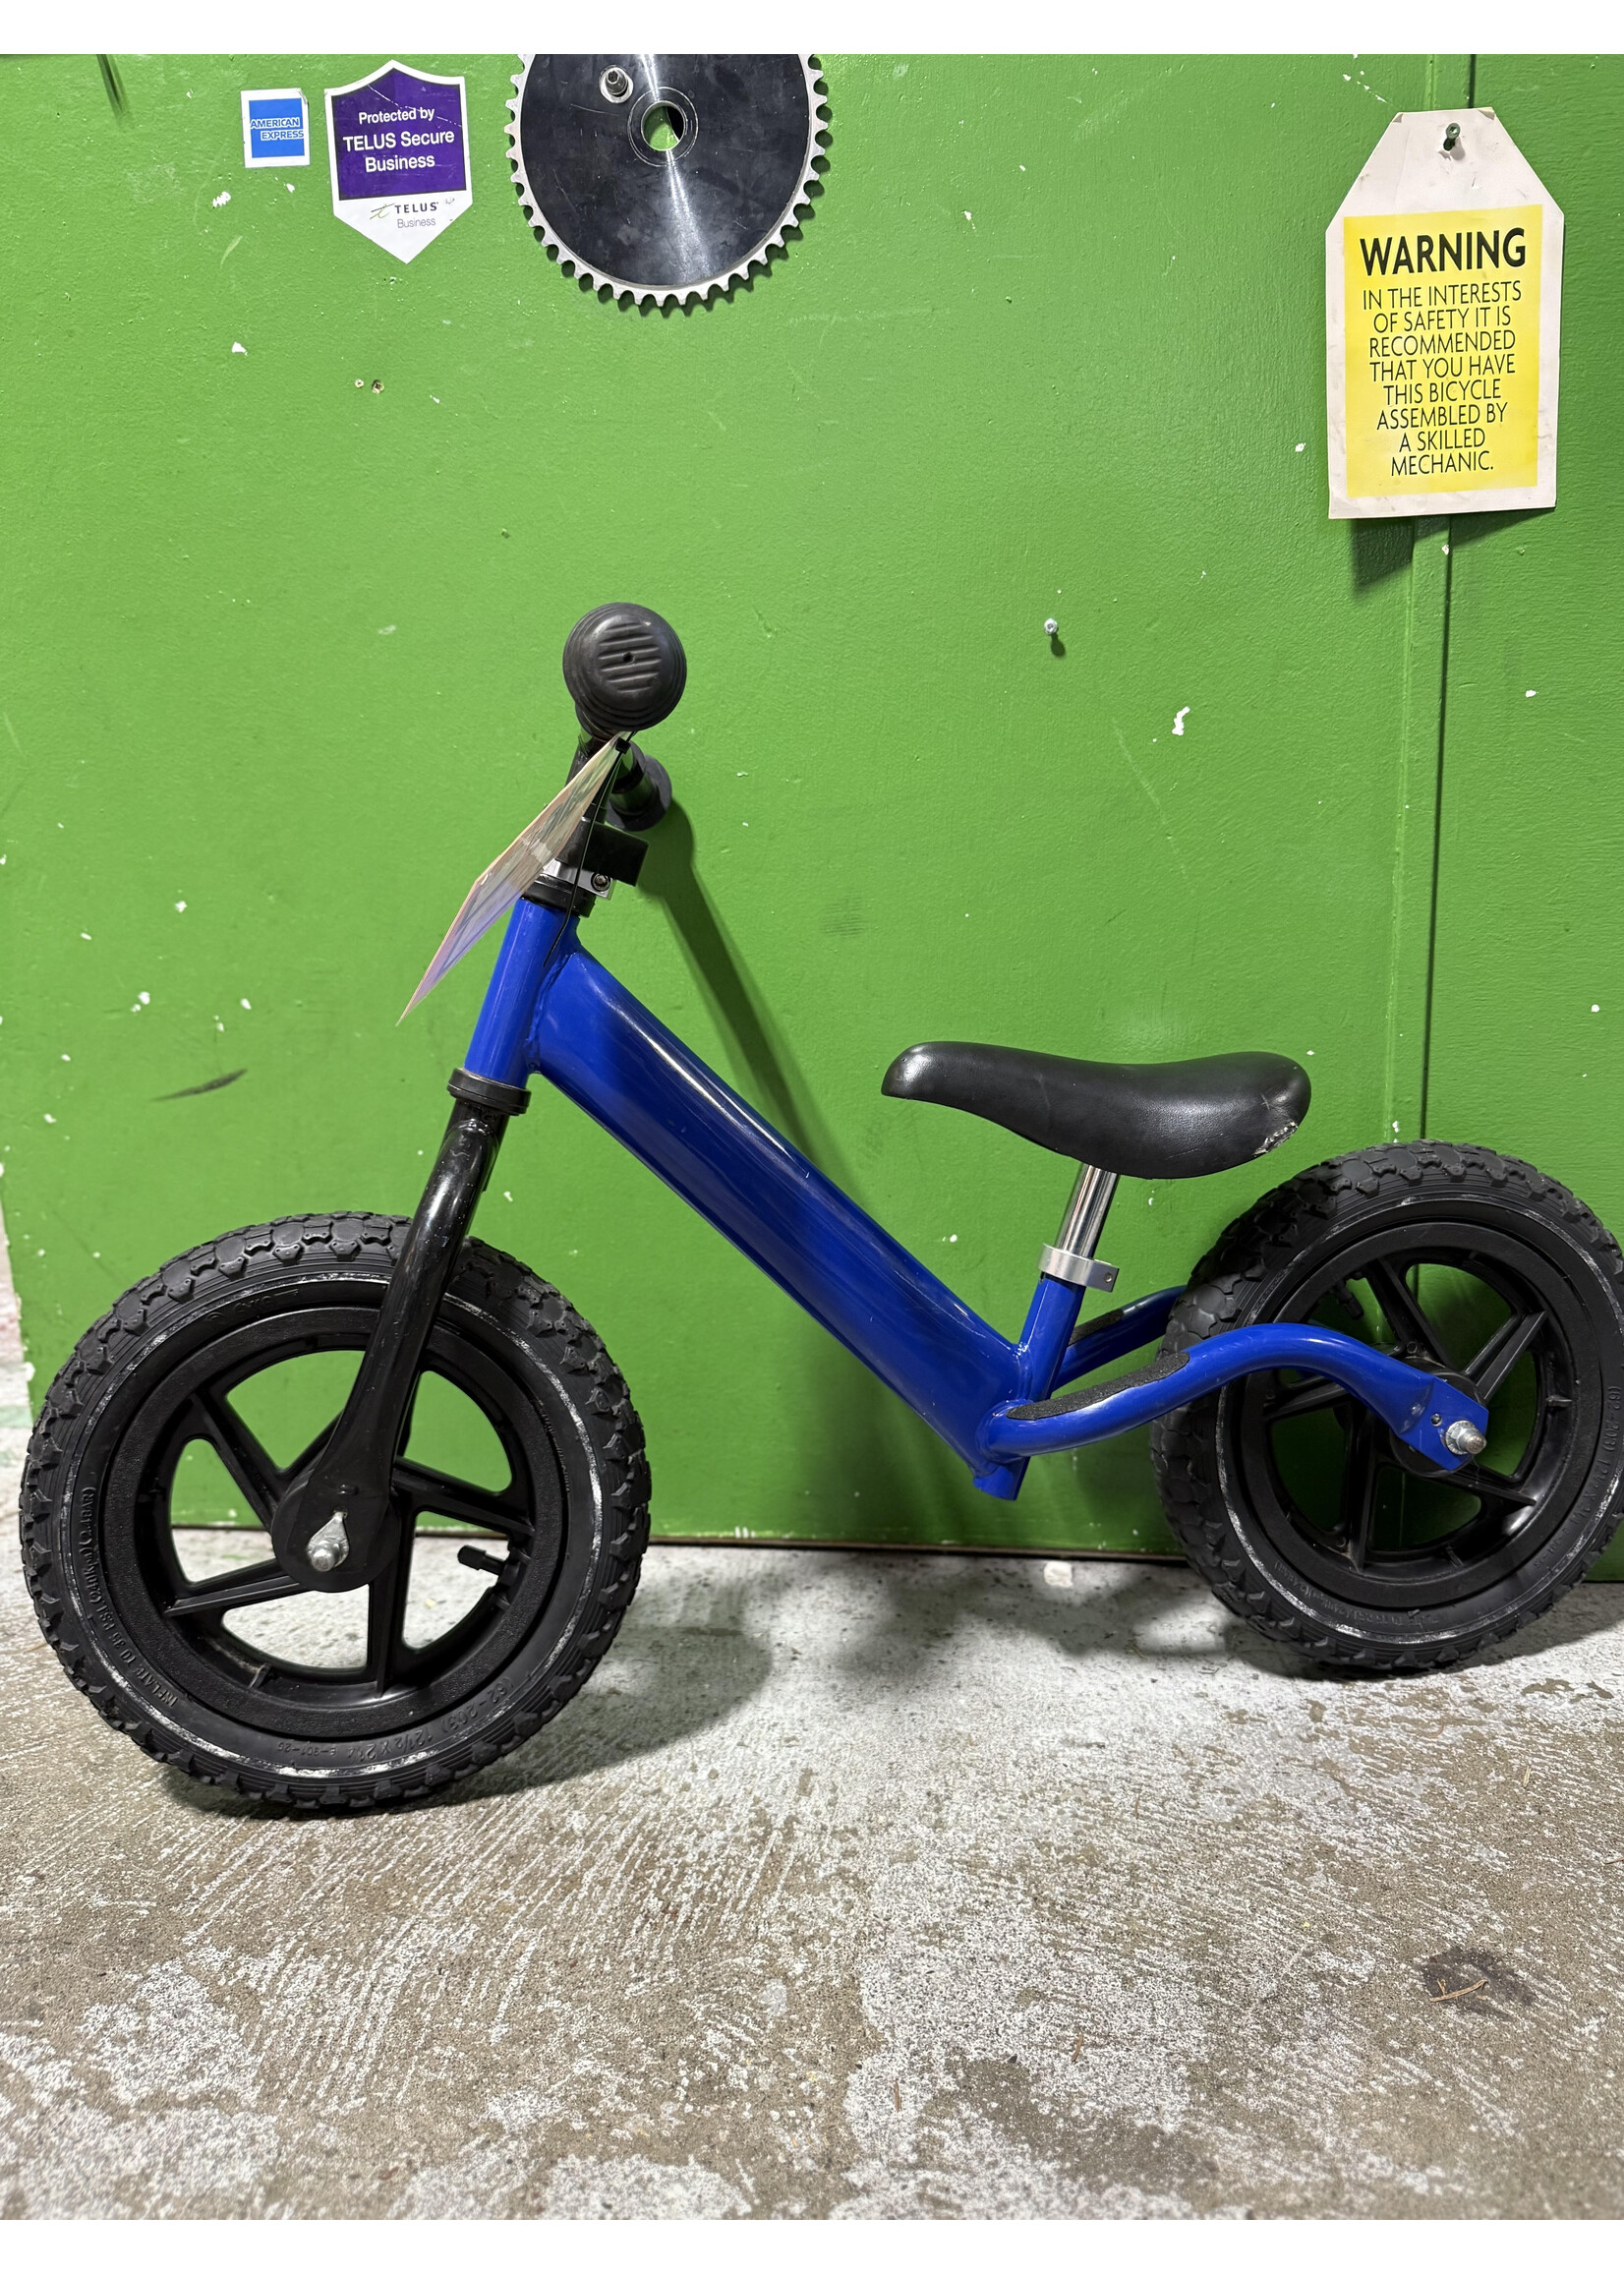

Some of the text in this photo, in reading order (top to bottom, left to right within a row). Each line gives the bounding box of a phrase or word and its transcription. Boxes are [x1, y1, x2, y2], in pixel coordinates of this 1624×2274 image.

[251, 118, 299, 128] AMERICAN
[359, 107, 435, 124] Protected by
[261, 131, 304, 140] EXPRESS
[343, 131, 454, 151] TELUS Secure
[366, 155, 435, 172] Business
[395, 203, 436, 213] TELUS
[397, 217, 435, 228] Business
[1360, 227, 1526, 276] WARNING
[1363, 280, 1522, 311] IN THE INTERESTS
[1373, 305, 1511, 333] OF SAFETY IT IS
[1369, 329, 1516, 358] RECOMMENDED
[1370, 354, 1515, 381] THAT YOU HAVE
[1383, 379, 1501, 406] THIS BICYCLE
[1376, 402, 1508, 431] ASSEMBLED BY
[1400, 428, 1485, 452] A SKILLED
[1391, 450, 1494, 476] MECHANIC.
